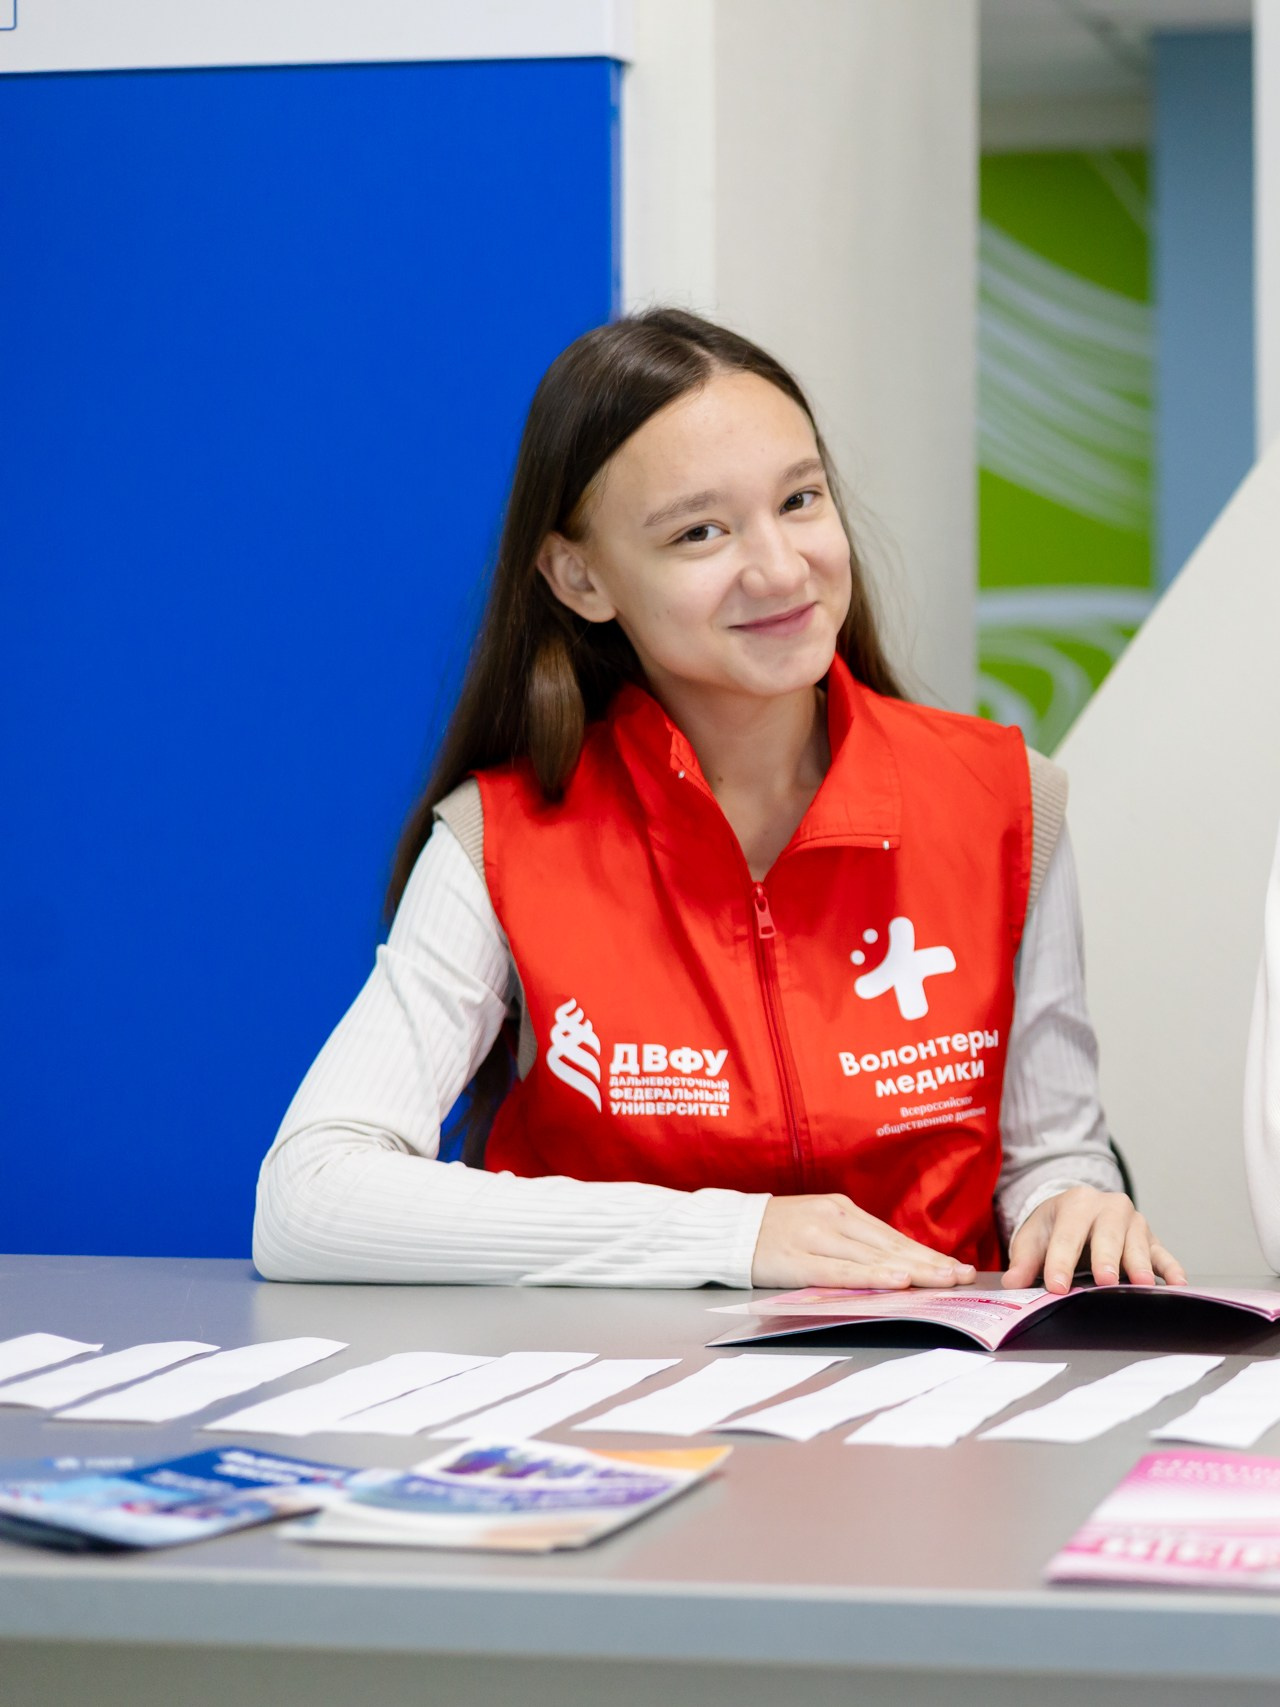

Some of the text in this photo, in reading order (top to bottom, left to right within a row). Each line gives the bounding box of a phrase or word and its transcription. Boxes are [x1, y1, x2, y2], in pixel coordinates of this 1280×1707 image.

[609, 1043, 729, 1077] ДВФУ
[838, 1029, 999, 1077] Волонтеры
[609, 1075, 730, 1091] ДАЛЬНЕВОСТОЧНЫЙ
[875, 1059, 985, 1098] медики
[609, 1087, 730, 1103] ФЕДЕРАЛЬНЫЙ
[609, 1101, 730, 1117] УНИВЕРСИТЕТ
[875, 1112, 955, 1138] общественное
